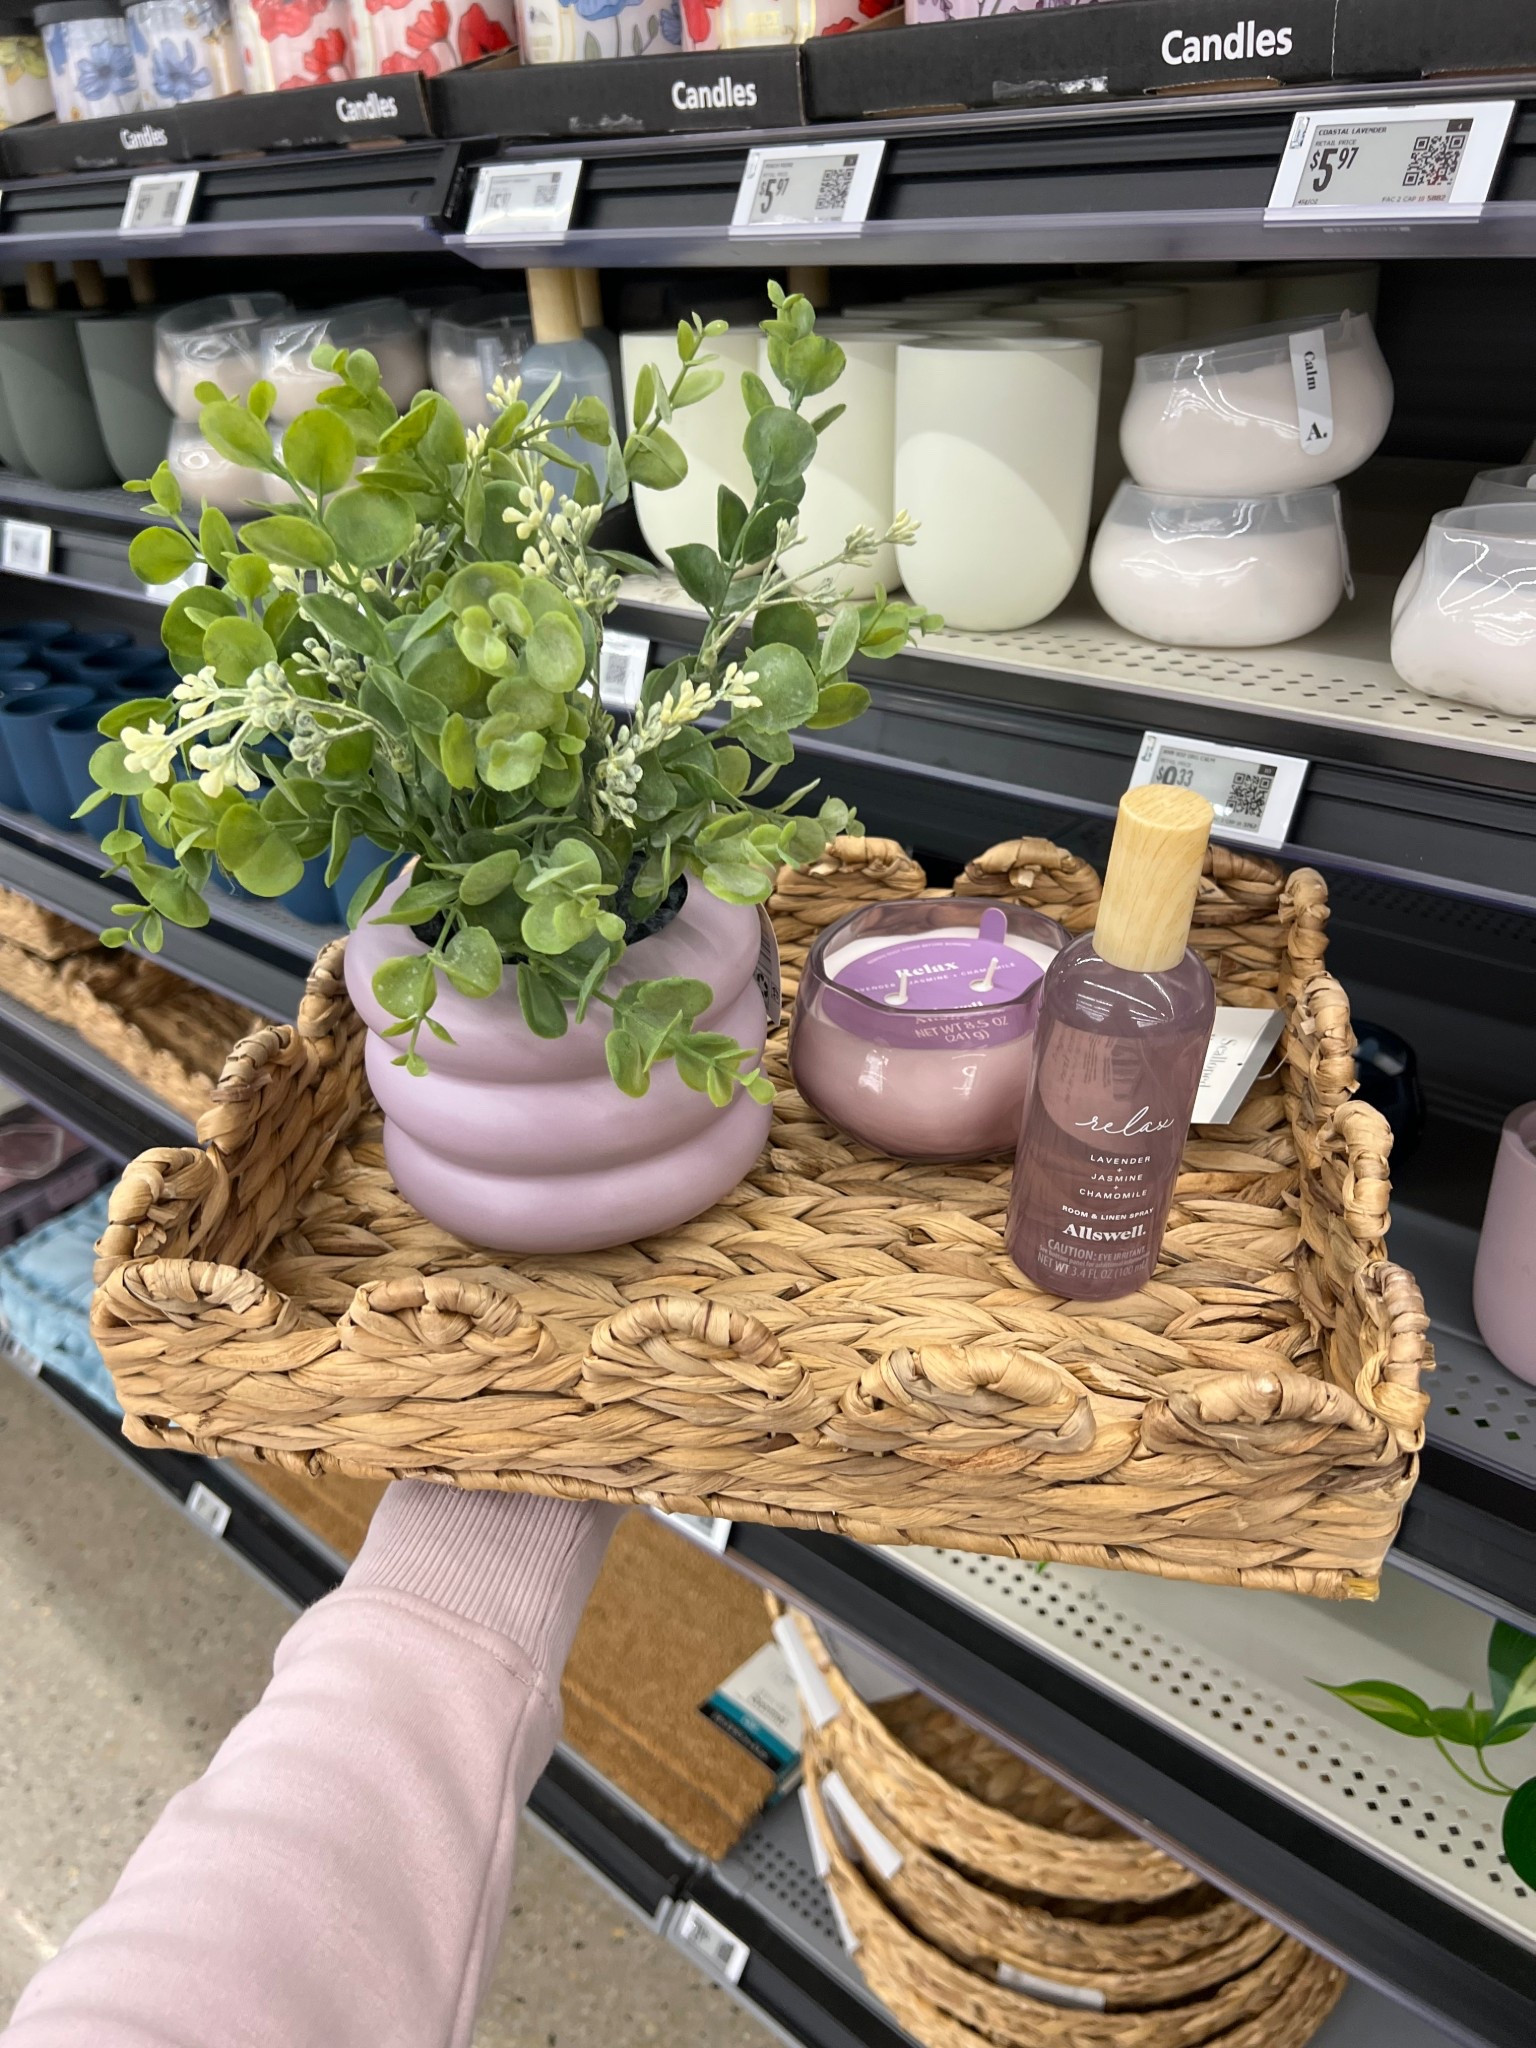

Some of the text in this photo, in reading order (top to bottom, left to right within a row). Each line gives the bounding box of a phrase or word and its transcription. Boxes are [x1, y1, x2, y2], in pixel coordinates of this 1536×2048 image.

[1161, 20, 1293, 65] Candles
[671, 76, 757, 110] Candles
[336, 91, 398, 123] Candles
[120, 124, 168, 150] Candles
[1318, 126, 1387, 136] COASTAL LAVENDER
[1338, 138, 1356, 146] PRICE
[1304, 351, 1318, 390] Calm
[1306, 422, 1328, 441] A.
[853, 983, 896, 992] AVENDER
[960, 962, 1016, 976] CHAMMILE
[895, 961, 959, 978] Relax
[915, 1027, 939, 1038] NET
[939, 1022, 962, 1034] WT
[991, 1016, 1009, 1026] OZ
[1075, 1105, 1174, 1136] relax
[1090, 1154, 1151, 1165] LAVENDER
[1091, 1172, 1144, 1182] JASMINE
[1079, 1188, 1148, 1200] CHAMOMILE
[1062, 1205, 1088, 1218] ROOM
[1128, 1207, 1154, 1219] SPRAY
[1062, 1223, 1147, 1242] Allswell.
[1047, 1239, 1098, 1260] CAUTION:
[1098, 1252, 1112, 1262] EYE
[1037, 1251, 1053, 1268] NET
[1054, 1261, 1070, 1275] WT
[1071, 1267, 1087, 1279] 3.4
[1088, 1268, 1098, 1280] FL
[1100, 1267, 1113, 1279] OZ
